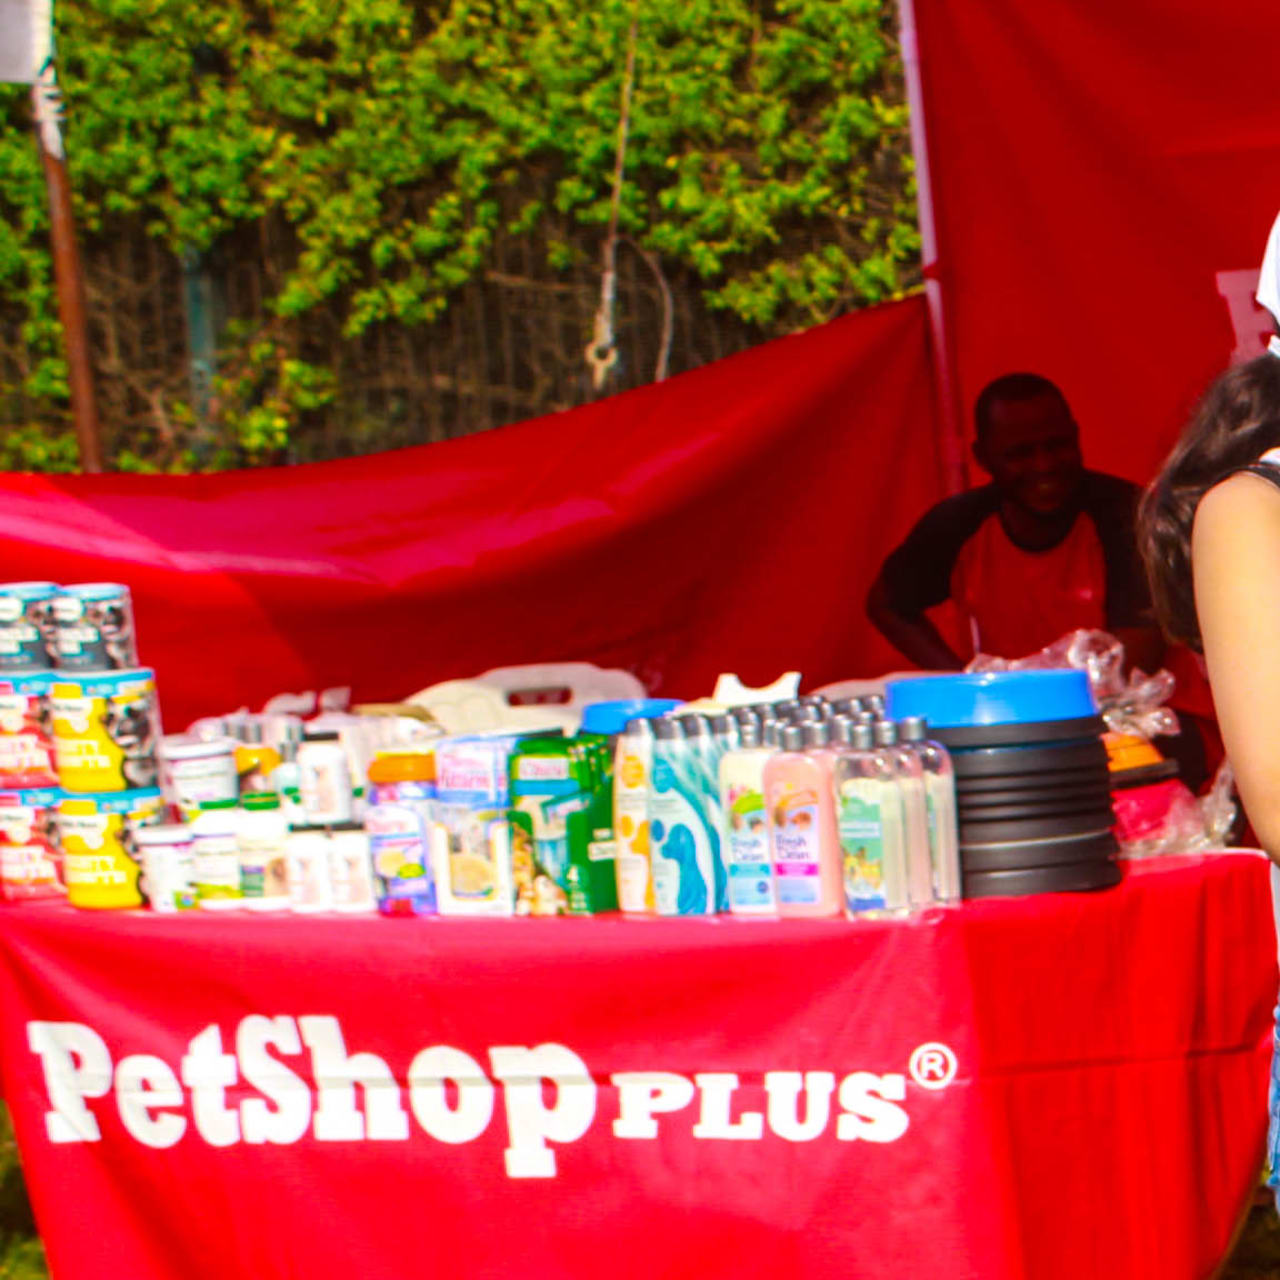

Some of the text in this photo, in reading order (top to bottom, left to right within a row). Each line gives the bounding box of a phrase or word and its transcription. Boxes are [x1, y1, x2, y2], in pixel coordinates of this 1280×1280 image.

[776, 833, 808, 849] Fresh
[778, 847, 811, 860] Clean
[27, 1015, 598, 1178] PetShop
